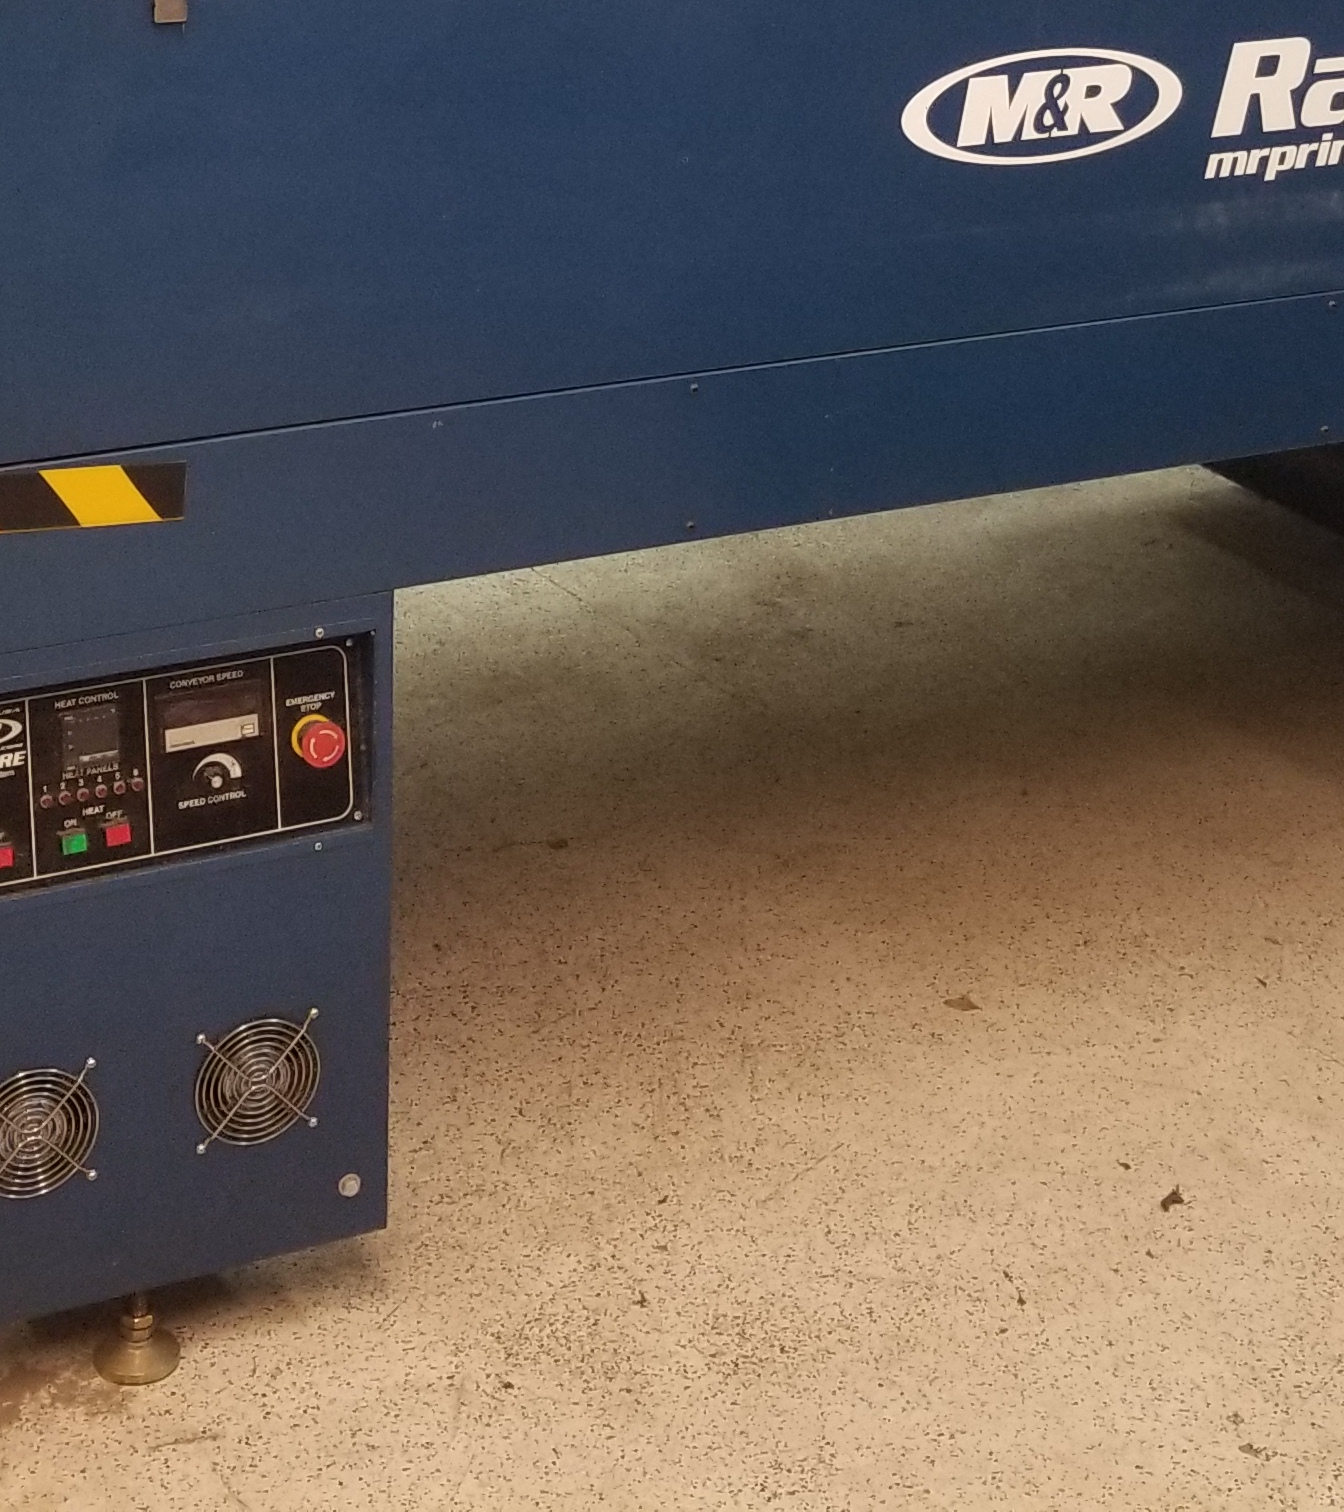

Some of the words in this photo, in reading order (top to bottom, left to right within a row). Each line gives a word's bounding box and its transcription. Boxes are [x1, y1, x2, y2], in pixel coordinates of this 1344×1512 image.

[957, 64, 1132, 147] M&R
[170, 674, 215, 689] CONVEYOR
[216, 670, 244, 681] SPEED
[54, 699, 77, 710] HEAT
[78, 691, 119, 706] CONTROL
[286, 691, 336, 707] EMERGENCY
[300, 702, 322, 713] STOP
[86, 763, 120, 775] PANELS
[178, 797, 206, 810] SPEED
[207, 791, 247, 805] CONTROL
[82, 805, 105, 817] HEAT
[63, 818, 77, 828] ON
